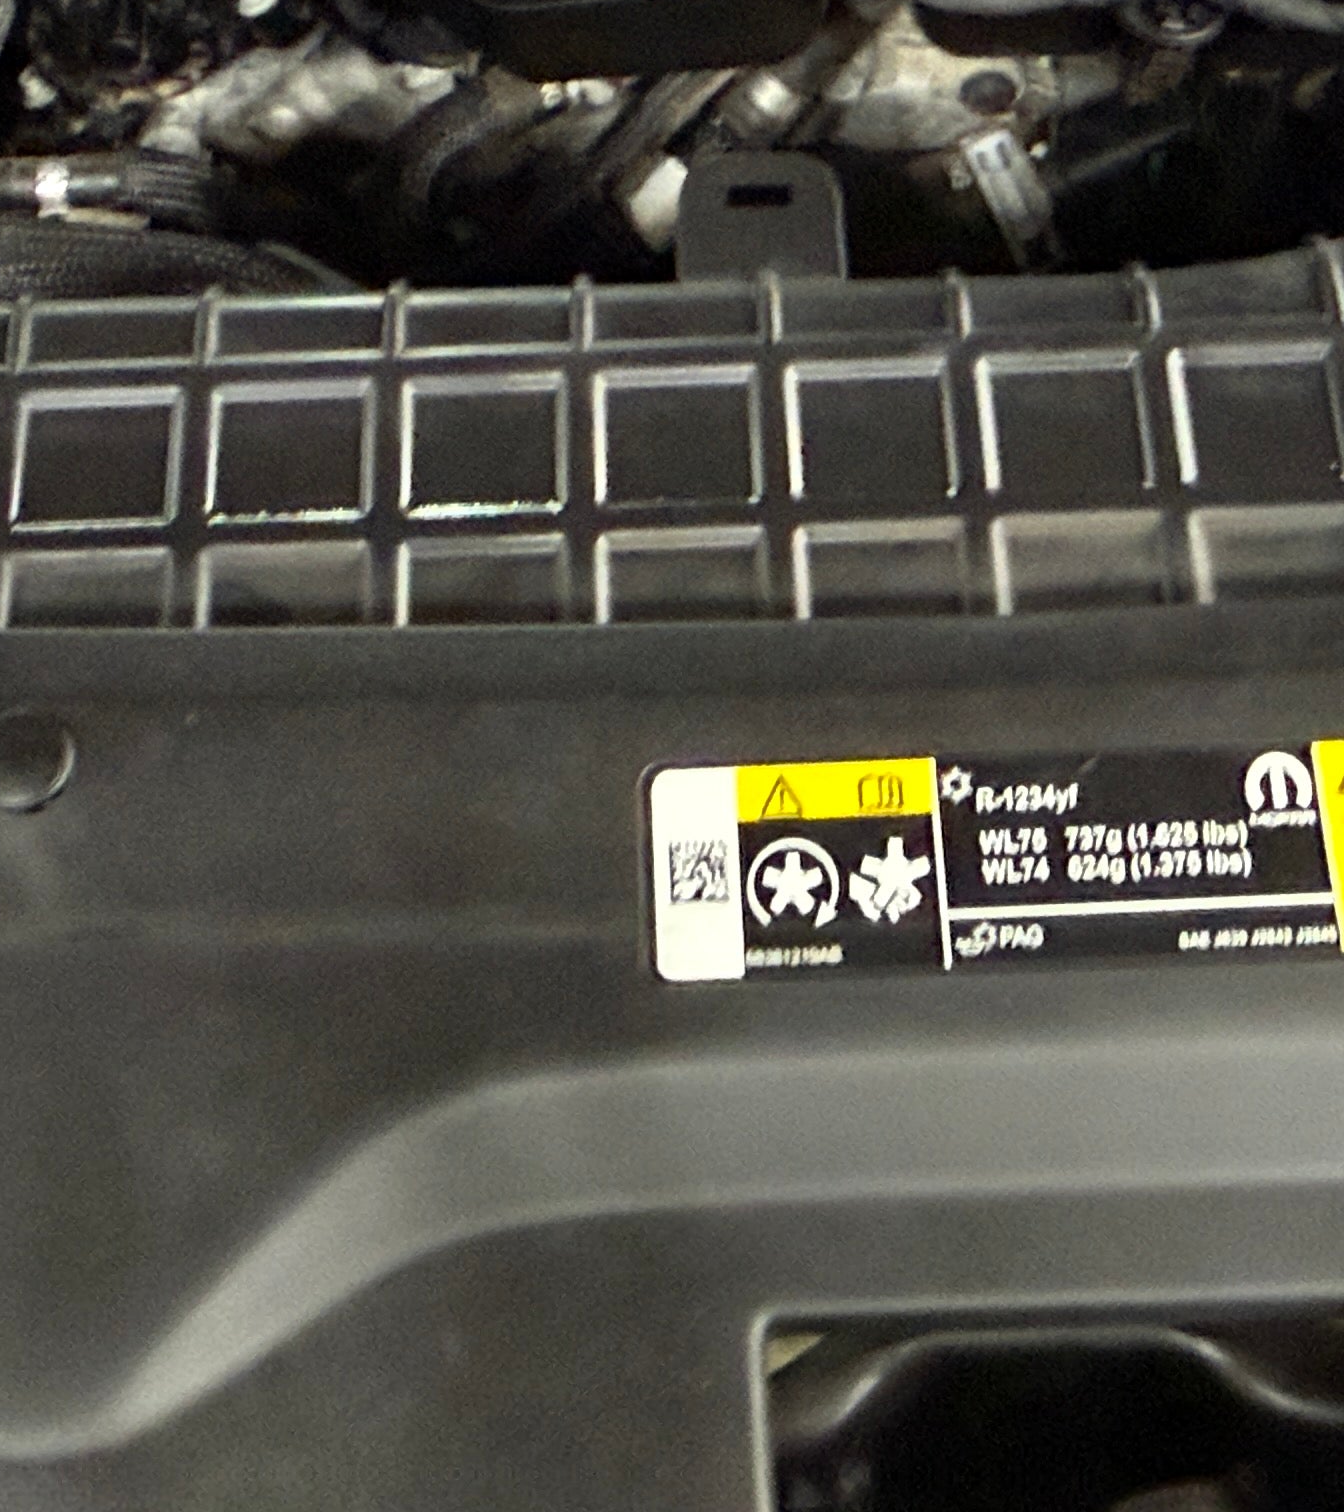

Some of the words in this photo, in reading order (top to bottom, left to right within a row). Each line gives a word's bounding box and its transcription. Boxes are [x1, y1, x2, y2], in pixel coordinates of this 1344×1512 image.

[1064, 823, 1123, 856] 737g
[1202, 819, 1249, 848] lbs)
[981, 856, 1051, 885] WL74
[1206, 848, 1253, 879] lbs)
